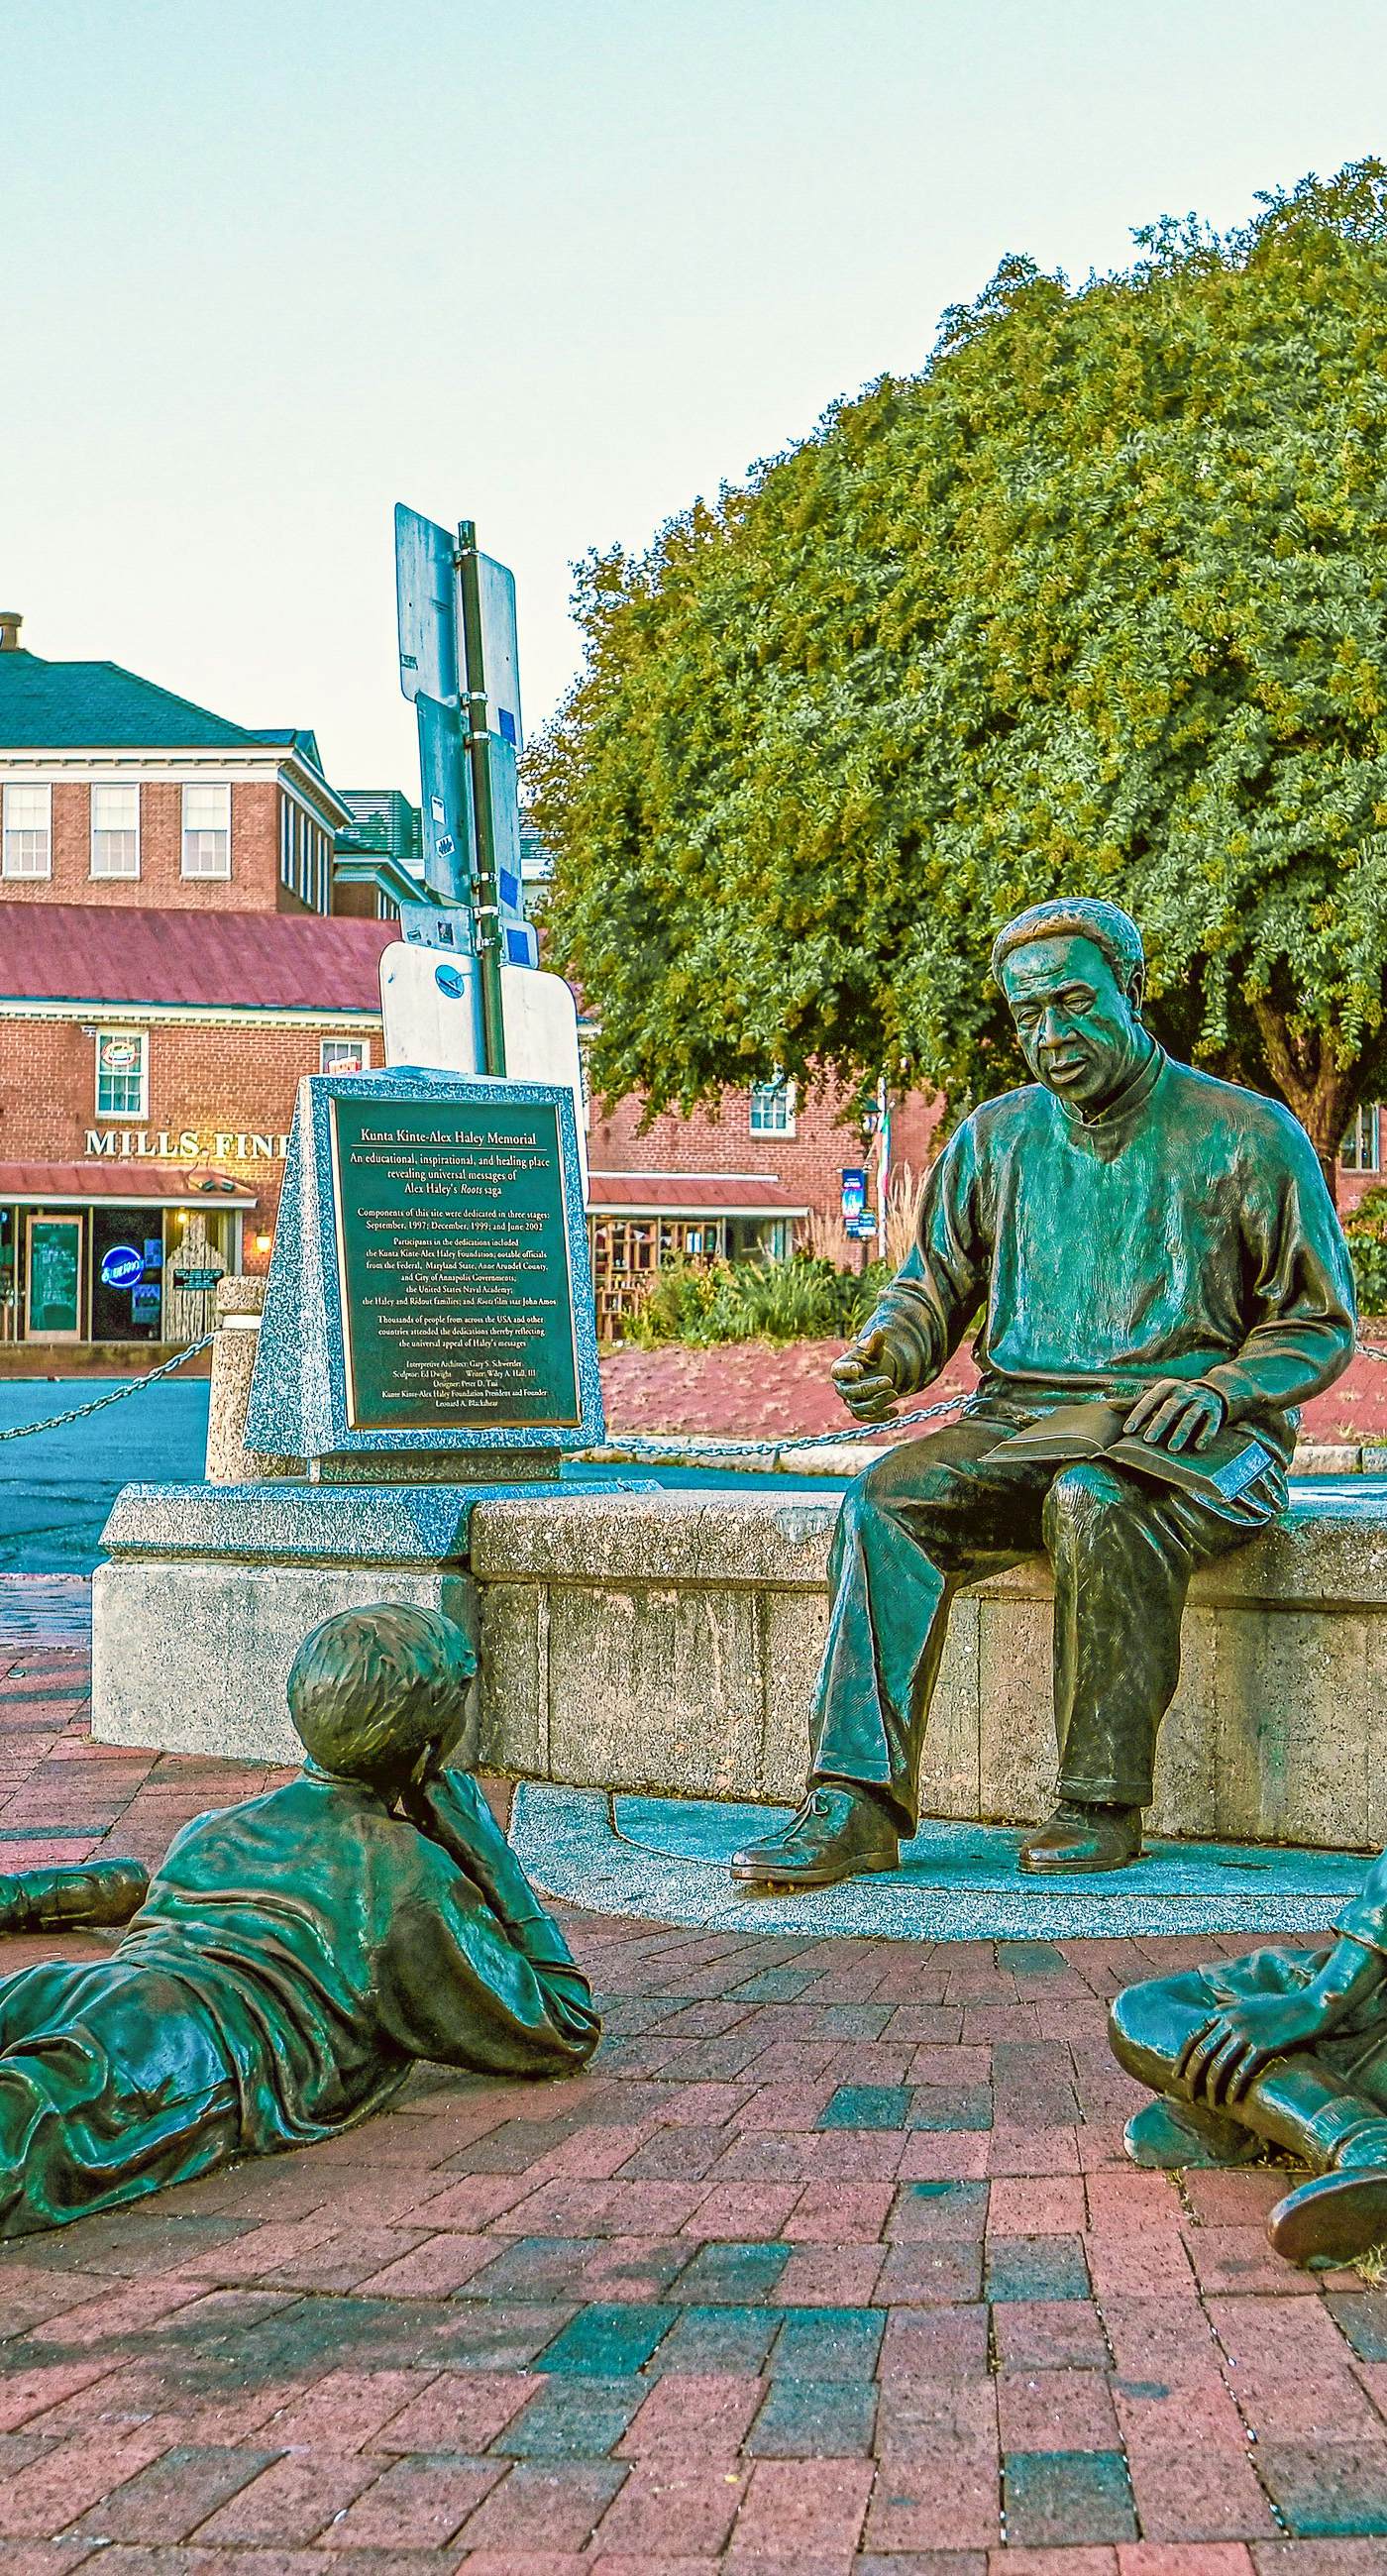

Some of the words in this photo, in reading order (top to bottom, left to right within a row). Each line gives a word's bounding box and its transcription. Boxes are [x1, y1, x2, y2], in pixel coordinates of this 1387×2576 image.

[84, 1129, 200, 1158] MILLS
[361, 1128, 394, 1141] Kunta
[396, 1129, 451, 1142] Kinte-Alex
[455, 1131, 484, 1145] Haley
[487, 1132, 536, 1144] Memorial
[350, 1153, 363, 1162] An
[364, 1153, 417, 1164] educational,
[419, 1154, 476, 1168] inspirational,
[478, 1155, 495, 1165] and
[495, 1155, 527, 1169] healing
[528, 1156, 550, 1169] place
[387, 1168, 426, 1181] revealing
[427, 1169, 466, 1179] universal
[468, 1172, 506, 1182] messages
[507, 1170, 517, 1180] of
[404, 1182, 424, 1193] Alex
[426, 1183, 457, 1196] Haley's
[460, 1183, 482, 1194] Roots
[484, 1187, 502, 1197] saga
[357, 1208, 404, 1219] Components
[405, 1208, 414, 1216] of
[415, 1208, 429, 1216] this
[430, 1208, 443, 1217] site
[463, 1209, 497, 1217] dedicated
[507, 1209, 525, 1218] three
[526, 1212, 549, 1221] stages:
[507, 1222, 523, 1231] June
[393, 1237, 432, 1247] Participants
